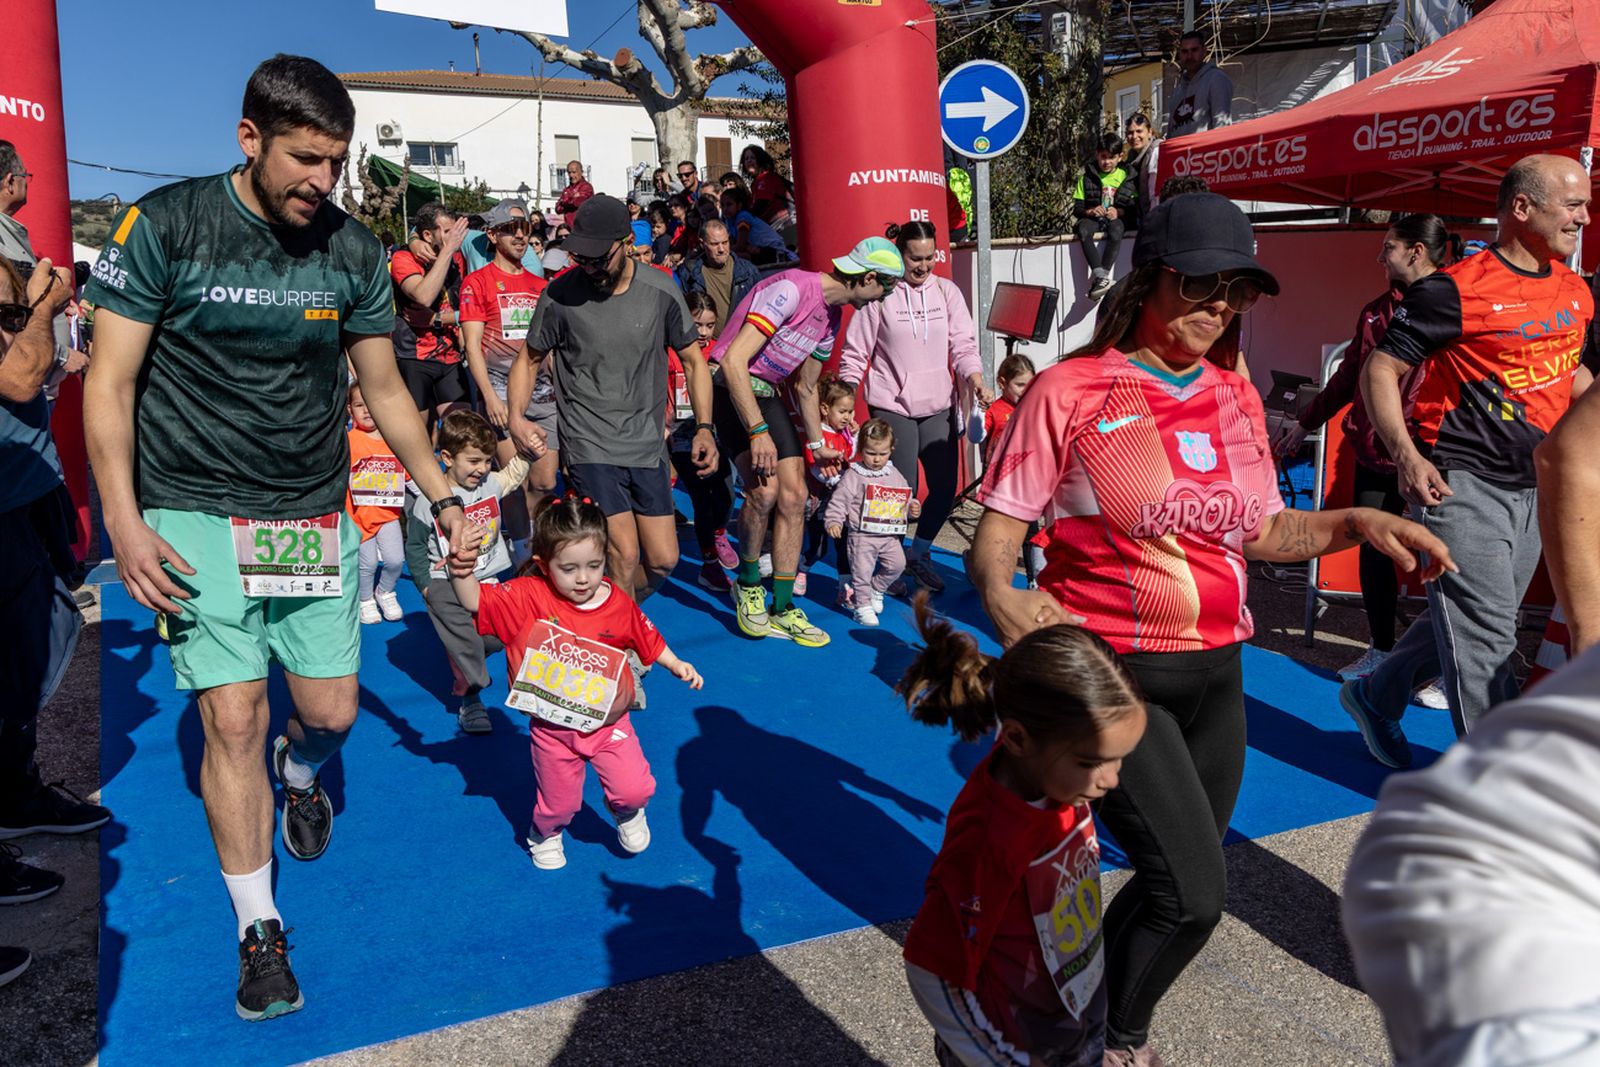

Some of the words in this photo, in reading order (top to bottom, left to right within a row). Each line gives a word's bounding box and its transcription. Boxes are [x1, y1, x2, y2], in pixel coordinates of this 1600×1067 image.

[1353, 94, 1556, 157] alssport.es
[1173, 134, 1307, 184] alssport.es
[1388, 149, 1415, 161] TIENDA
[1503, 130, 1553, 145] OUTDOOR
[910, 208, 930, 223] DE
[200, 286, 338, 309] LOVEBURPEE
[1498, 326, 1585, 364] SIERR
[1502, 347, 1582, 389] ELVIR
[248, 519, 312, 531] PANTANO
[1131, 496, 1241, 539] KAROL
[1241, 492, 1263, 533] G
[255, 528, 322, 564] 528
[542, 628, 562, 650] X
[560, 642, 609, 668] CROSS
[526, 652, 608, 705] 5036
